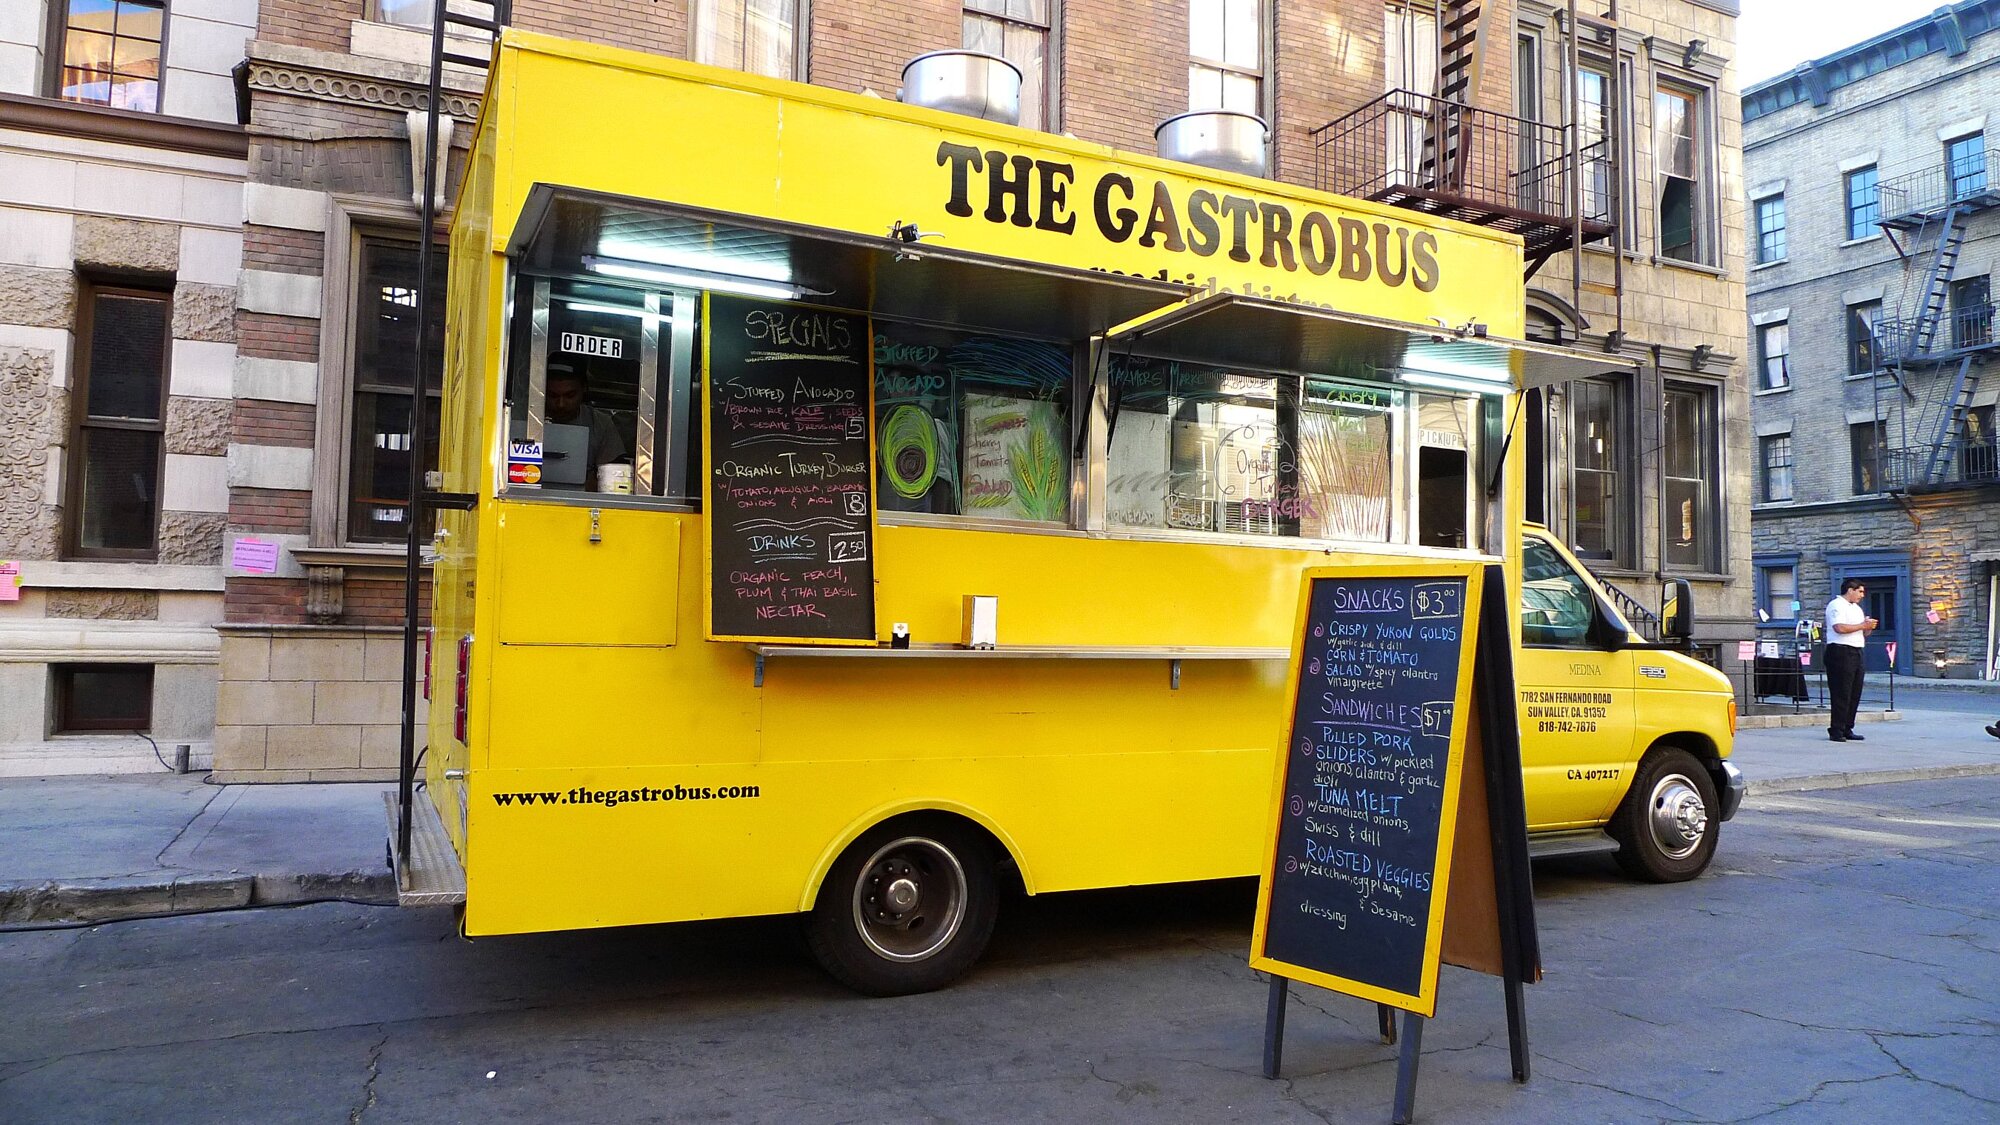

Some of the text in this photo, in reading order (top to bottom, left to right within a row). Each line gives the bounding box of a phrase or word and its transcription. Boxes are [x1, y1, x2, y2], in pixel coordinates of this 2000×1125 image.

[936, 141, 1438, 292] THE GASTROBUS
[745, 311, 851, 350] SPECIALS
[563, 334, 621, 357] ORDER
[726, 376, 855, 403] STUFFED AVOCADO
[874, 368, 945, 395] AVOCADO
[835, 407, 863, 417] SEEDS
[732, 415, 844, 431] & SESAME DRESSING
[848, 419, 862, 434] 5
[514, 444, 541, 455] VISA
[723, 452, 867, 479] ORGANIC TURKEY BURGER
[738, 499, 776, 508] ONIONS
[849, 495, 864, 513] 8
[1242, 498, 1318, 519] BURGER
[748, 534, 816, 552] DRINKS
[730, 568, 790, 584] ORGANIC
[736, 587, 857, 601] PLUM & THAI BASIL
[1334, 586, 1405, 610] SNACKS
[756, 604, 826, 620] NECTAR
[1330, 620, 1456, 641] CRISPY YUKON GOLDS
[1386, 641, 1402, 650] dill
[1326, 649, 1356, 662] CORN
[1367, 649, 1419, 666] TOMATO
[1325, 664, 1362, 677] SALAD
[1402, 668, 1439, 681] cilantro
[1569, 664, 1601, 676] MEDINA
[1327, 676, 1385, 692] vinaigrette
[1521, 691, 1612, 704] 7782 SAN FERNANDO ROAD
[1321, 692, 1423, 728] SANDWICHES
[1528, 706, 1543, 718] SUN
[1583, 706, 1606, 718] 91352
[1323, 726, 1414, 756] PULLED PORK
[1316, 744, 1377, 765] SLIDERS
[1567, 769, 1619, 781] CA 407217
[493, 784, 760, 807] www.thegastrobus.com
[1315, 784, 1403, 817] TUNA MELT
[1360, 827, 1381, 847] dill
[1306, 838, 1431, 891] ROASTED VEGGIES
[1300, 900, 1347, 930] dressing
